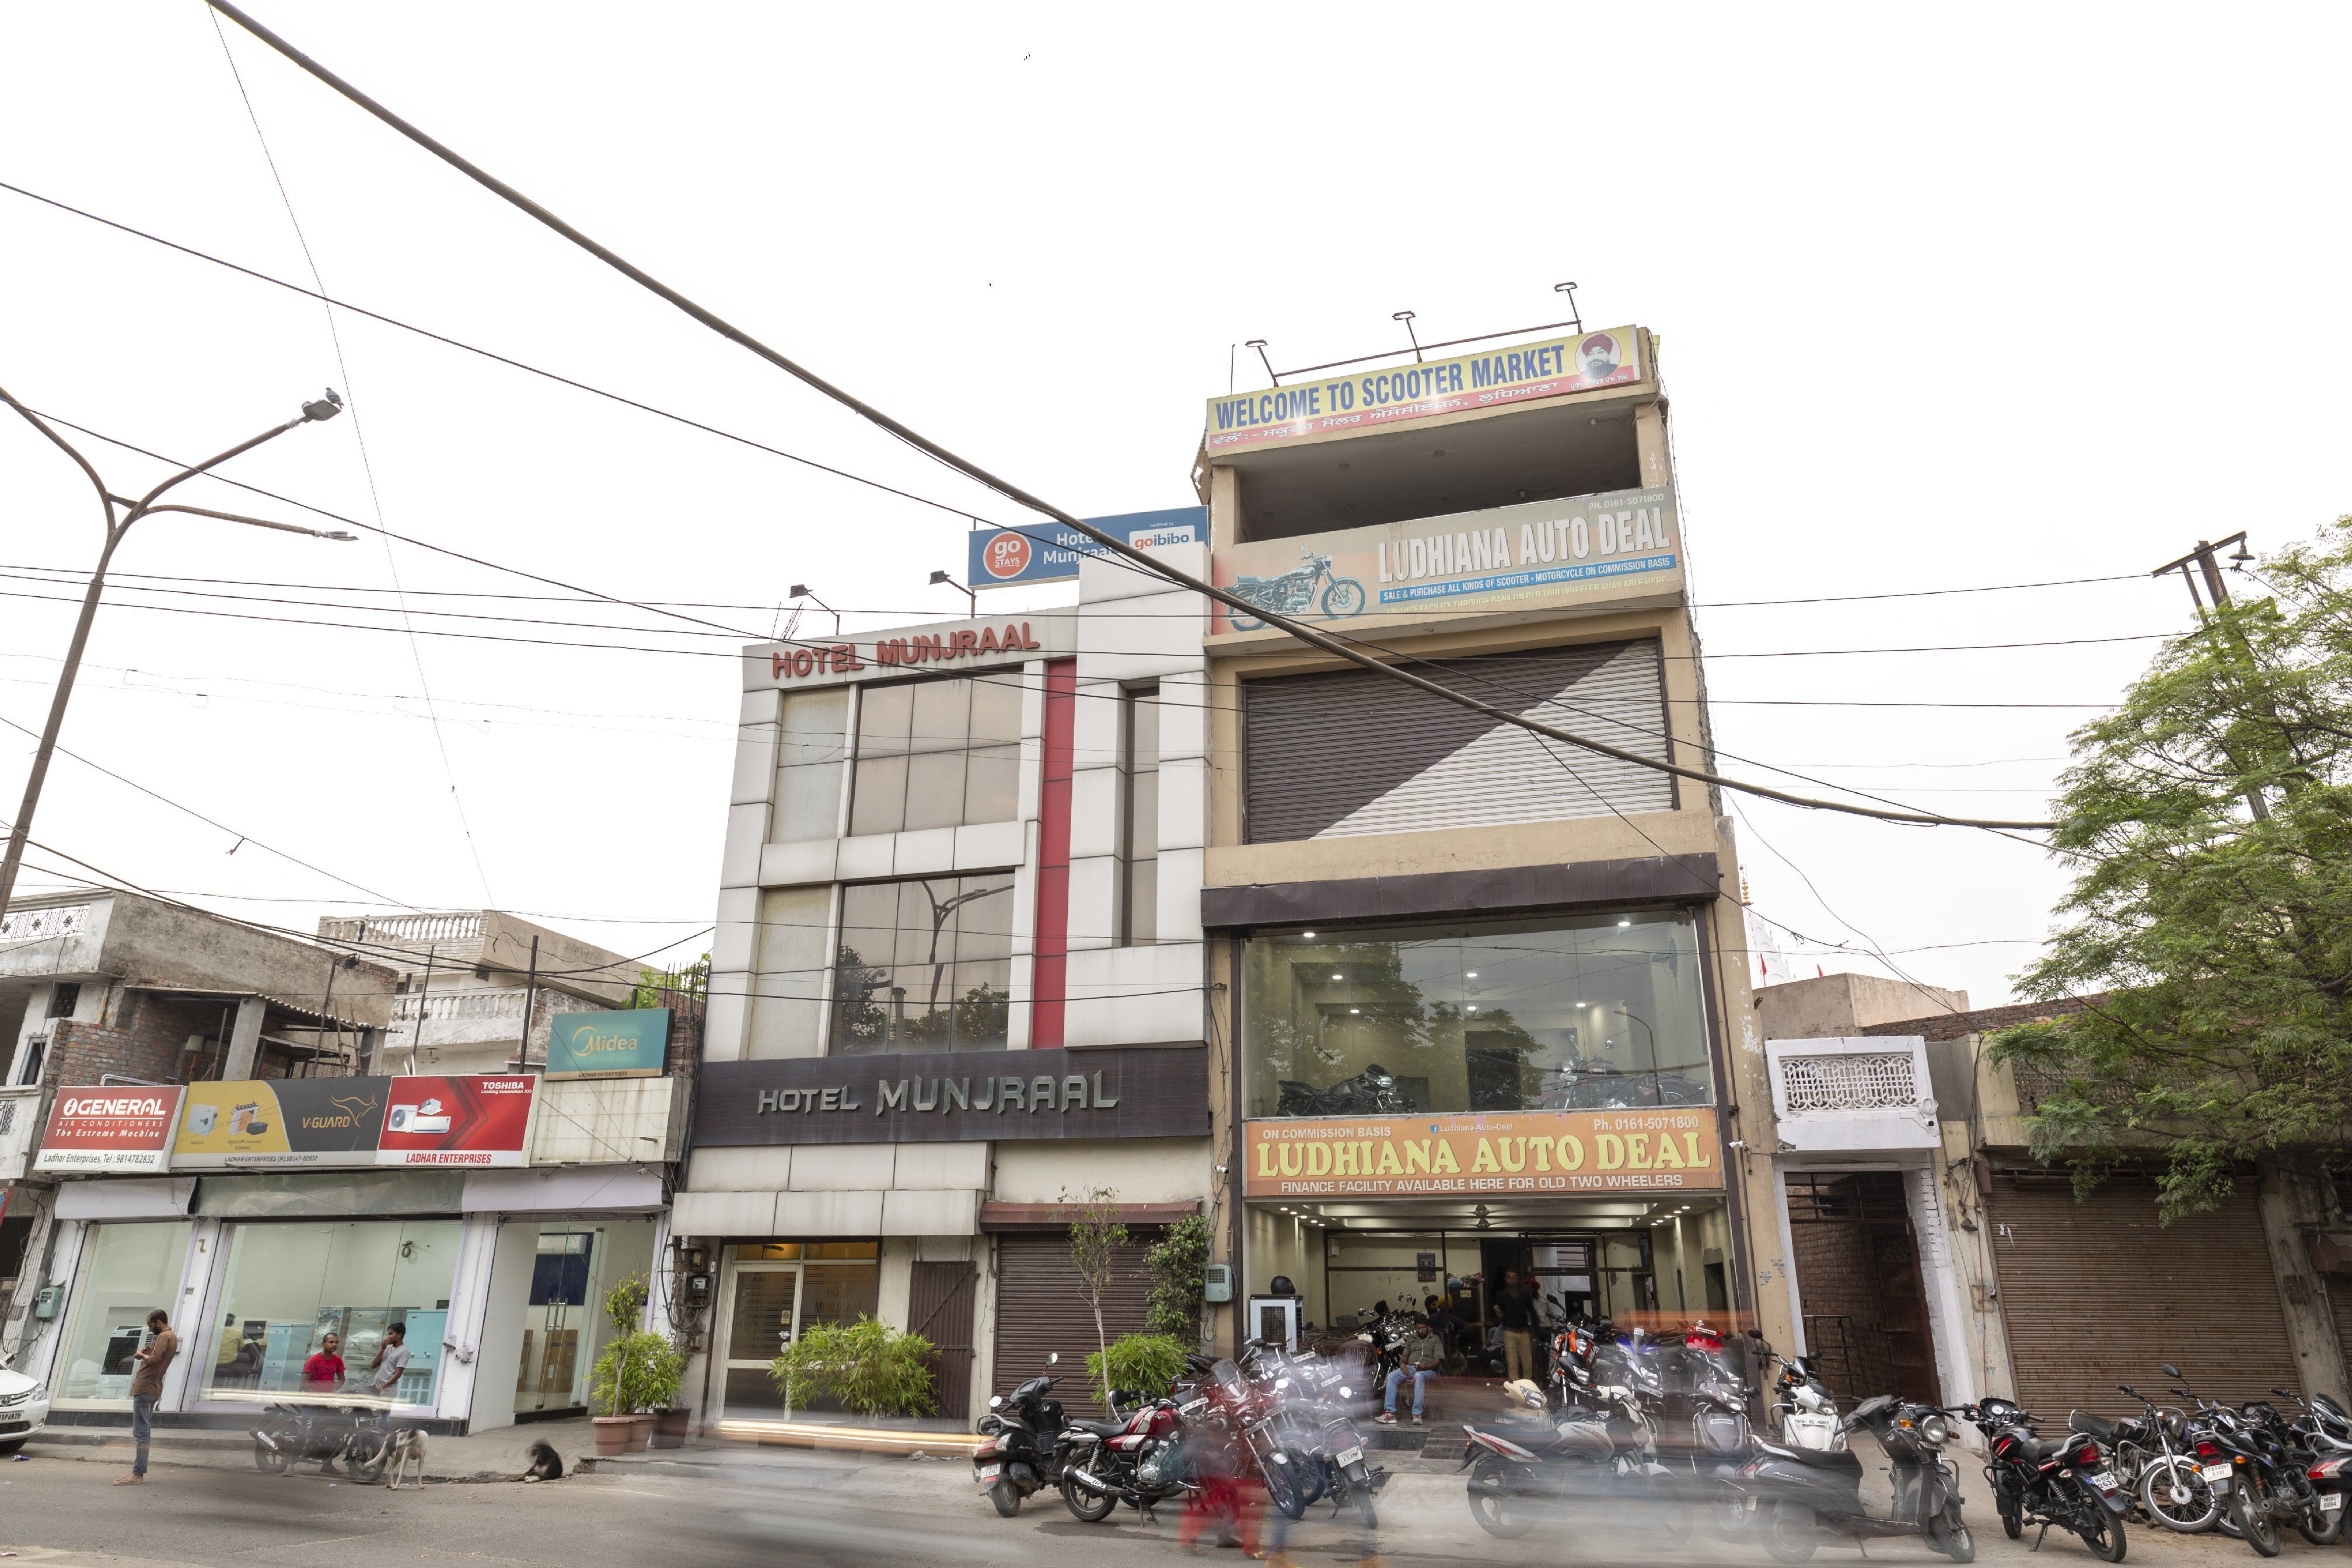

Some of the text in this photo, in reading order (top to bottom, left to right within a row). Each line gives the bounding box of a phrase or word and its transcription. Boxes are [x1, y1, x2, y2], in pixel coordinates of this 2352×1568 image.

[1215, 345, 1564, 430] WELCOME TO SCOOTER MARKET
[1588, 493, 1664, 510] PH. 0161-5071800
[1057, 528, 1096, 546] Hote
[1134, 533, 1190, 550] goibibo
[1378, 507, 1671, 583] LUDHIANA AUTO DEAL
[994, 539, 1021, 567] go STAYS
[1383, 557, 1670, 600] SALE & PURCHASE ALL KINDS OF SCOOTER MOTORCYCLE ON COMMISSION BASIS
[773, 622, 1040, 678] HOTEL MUNJRAAL
[579, 1032, 638, 1052] Midea
[758, 1069, 1119, 1116] HOTEL MUNJRAAL
[77, 1098, 166, 1115] GENERAL
[302, 1116, 350, 1129] V-GUARD
[1263, 1129, 1280, 1139] ON
[1282, 1128, 1354, 1139] COMMISSION
[1357, 1126, 1392, 1137] BASIS
[1440, 1122, 1513, 1132] Ludhiana-Auto-Deal
[1593, 1118, 1612, 1131] Ph.
[1614, 1116, 1699, 1130] 0161-5071800
[55, 1129, 72, 1137] The
[119, 1129, 160, 1138] Machine
[44, 1153, 66, 1163] Ladhar
[66, 1153, 102, 1166] Enterprises,
[116, 1154, 155, 1164] 9814782832
[406, 1153, 491, 1164] LADHAR ENTERPRISES
[1257, 1132, 1711, 1177] LUDHIANA AUTO DEAL
[1281, 1174, 1683, 1193] FINANCE FACILITY AVAILABLE HERE FOR OLD TWO WHEELERS
